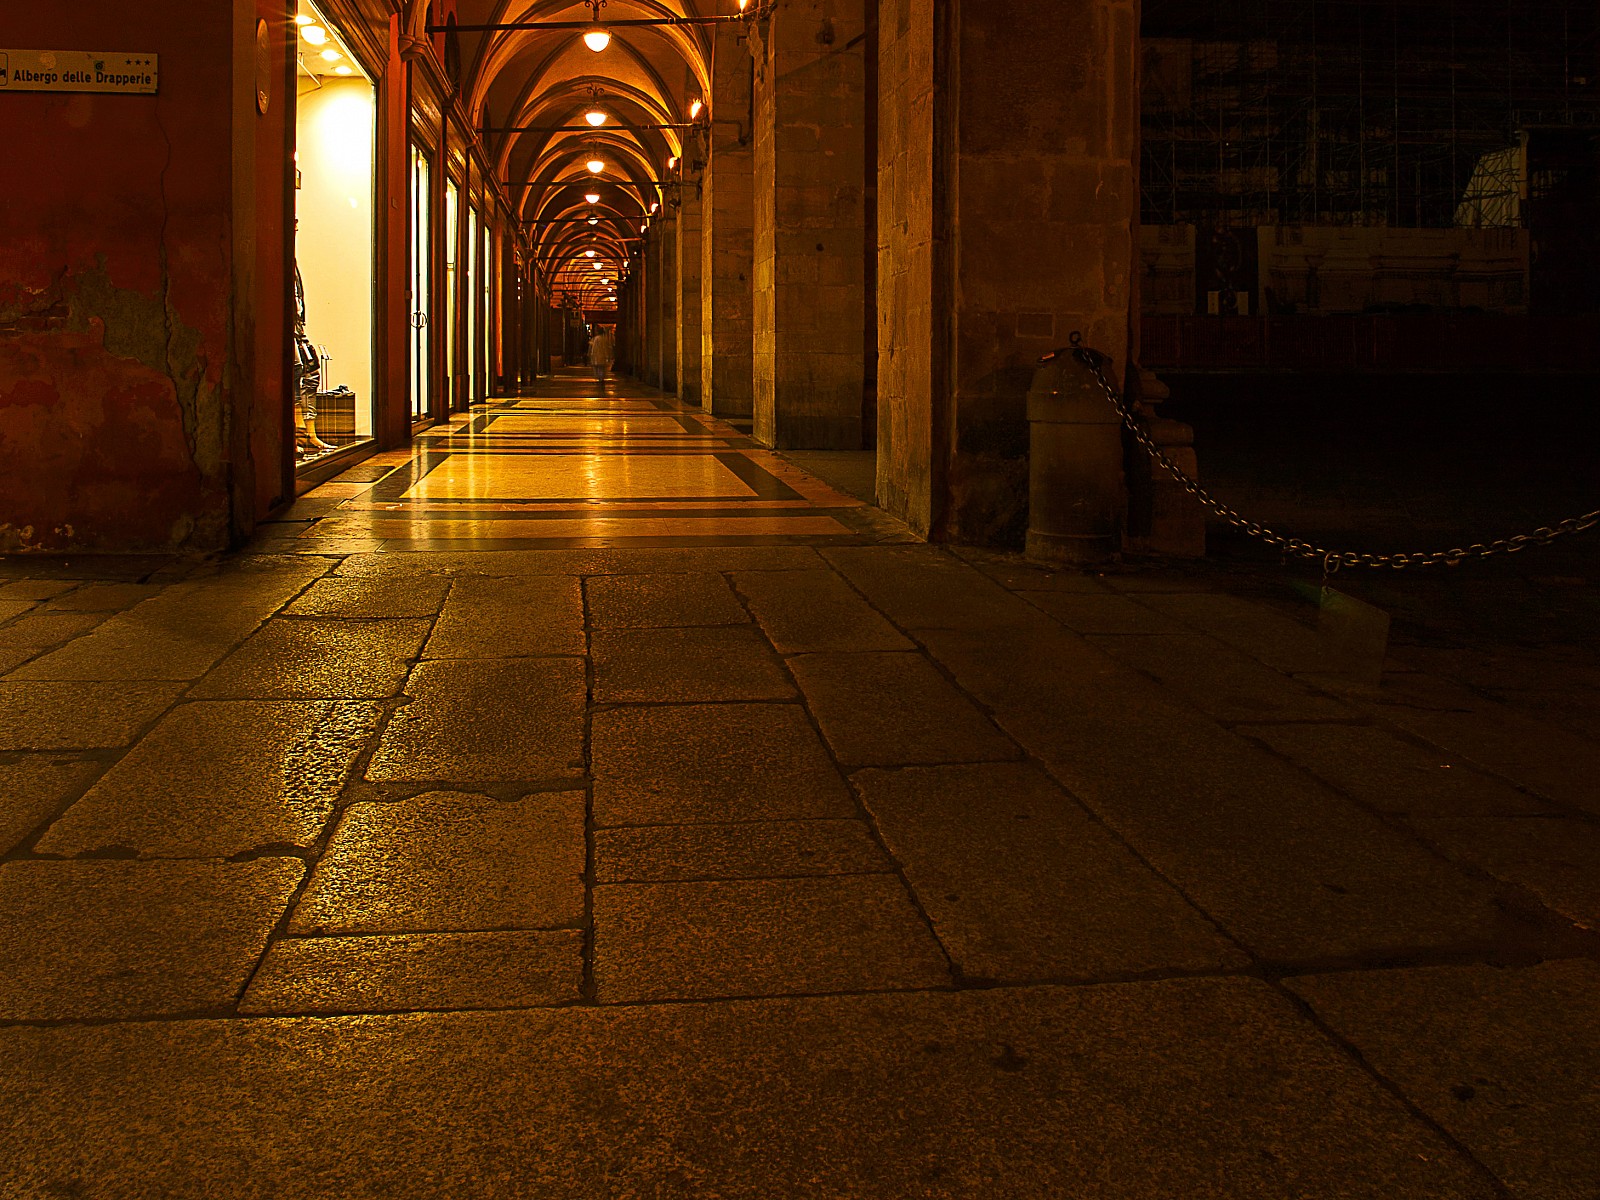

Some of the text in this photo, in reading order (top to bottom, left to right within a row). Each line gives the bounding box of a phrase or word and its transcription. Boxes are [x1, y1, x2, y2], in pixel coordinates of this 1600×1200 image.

[13, 69, 151, 86] Albergo delle Drapperie
